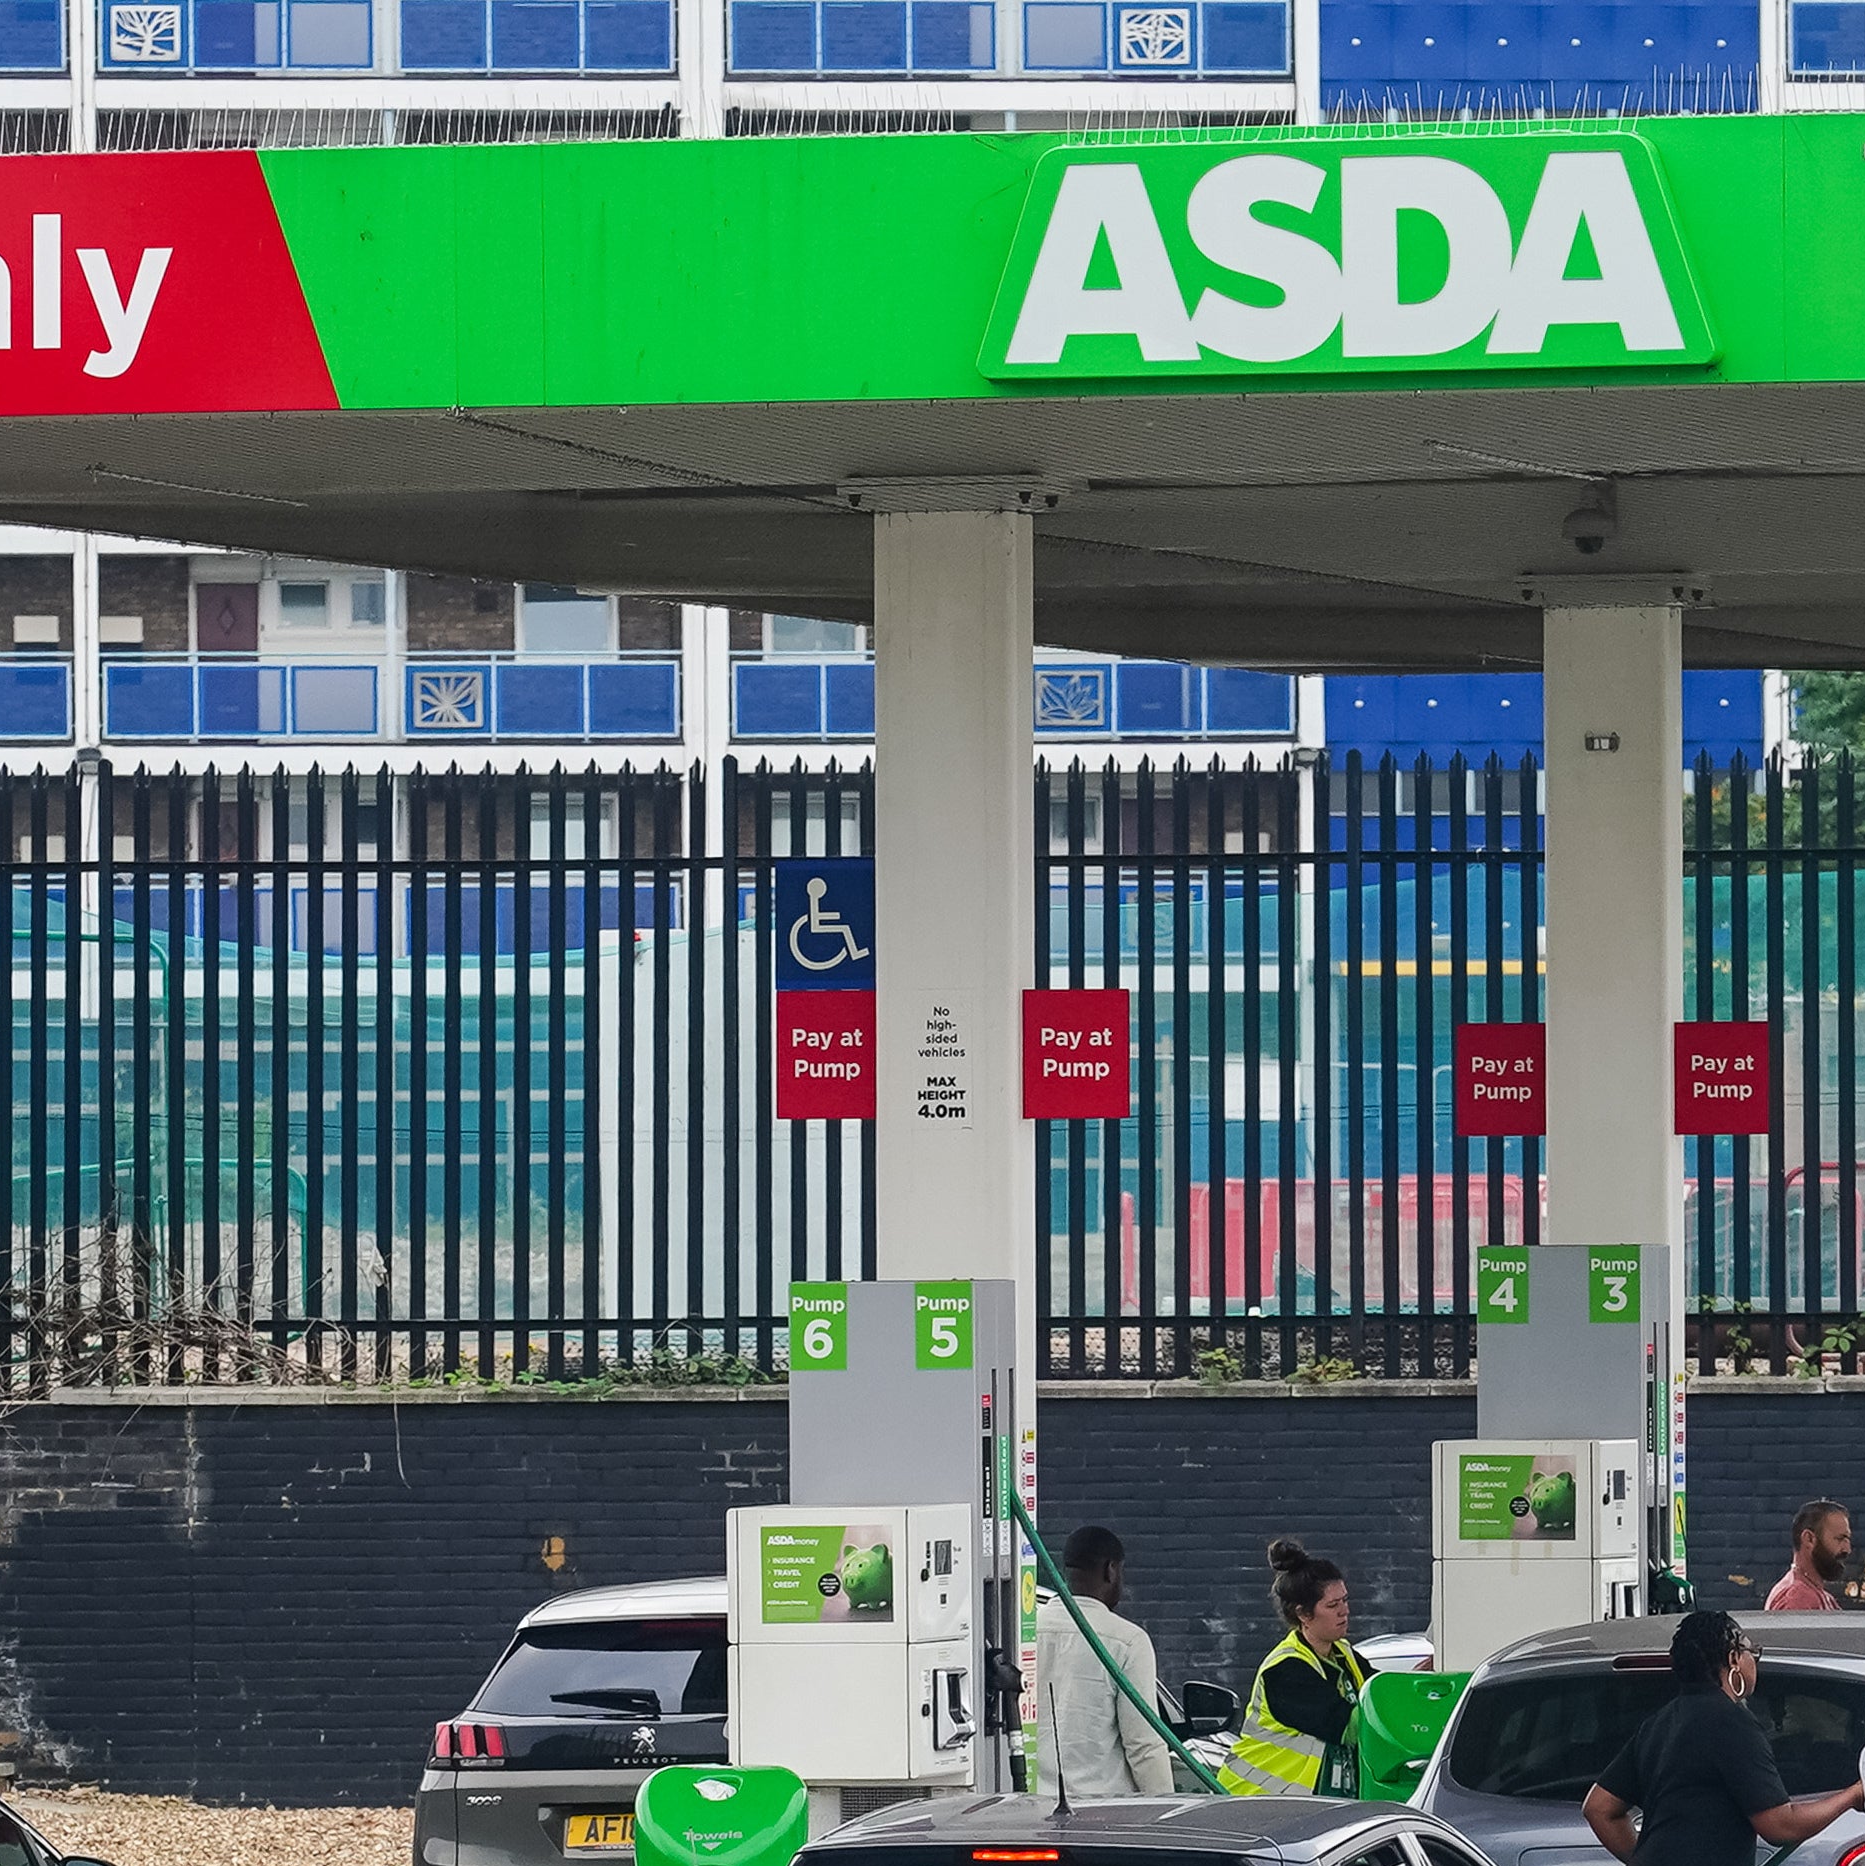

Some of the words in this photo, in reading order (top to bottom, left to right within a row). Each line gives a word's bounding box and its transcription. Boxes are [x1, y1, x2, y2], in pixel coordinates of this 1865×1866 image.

[1004, 152, 1686, 364] ASDA
[933, 1006, 950, 1017] No
[926, 1019, 957, 1032] high-
[791, 1028, 834, 1050] Pay
[840, 1028, 863, 1047] at
[925, 1033, 957, 1045] sided
[1040, 1027, 1083, 1049] Pay
[1089, 1027, 1112, 1046] at
[918, 1048, 966, 1058] vehicles
[794, 1059, 861, 1081] Pump
[1042, 1058, 1110, 1080] Pump
[1471, 1056, 1508, 1075] Pay
[1514, 1056, 1534, 1073] at
[1690, 1055, 1728, 1074] Pay
[1734, 1055, 1754, 1071] at
[927, 1076, 956, 1087] MAX
[918, 1090, 966, 1101] HEIGHT
[1473, 1083, 1532, 1102] Pump
[1693, 1082, 1753, 1101] Pump
[918, 1104, 966, 1119] 4.0m
[1480, 1259, 1527, 1275] Pump
[1590, 1258, 1638, 1274] Pump
[1488, 1277, 1519, 1313] 4
[1602, 1276, 1628, 1312] 3
[792, 1297, 845, 1314] Pump
[916, 1296, 970, 1313] Pump
[803, 1319, 833, 1359] 6
[929, 1317, 959, 1358] 5
[773, 1568, 802, 1577] TRAVEL
[613, 1757, 679, 1765] PEUGEOT
